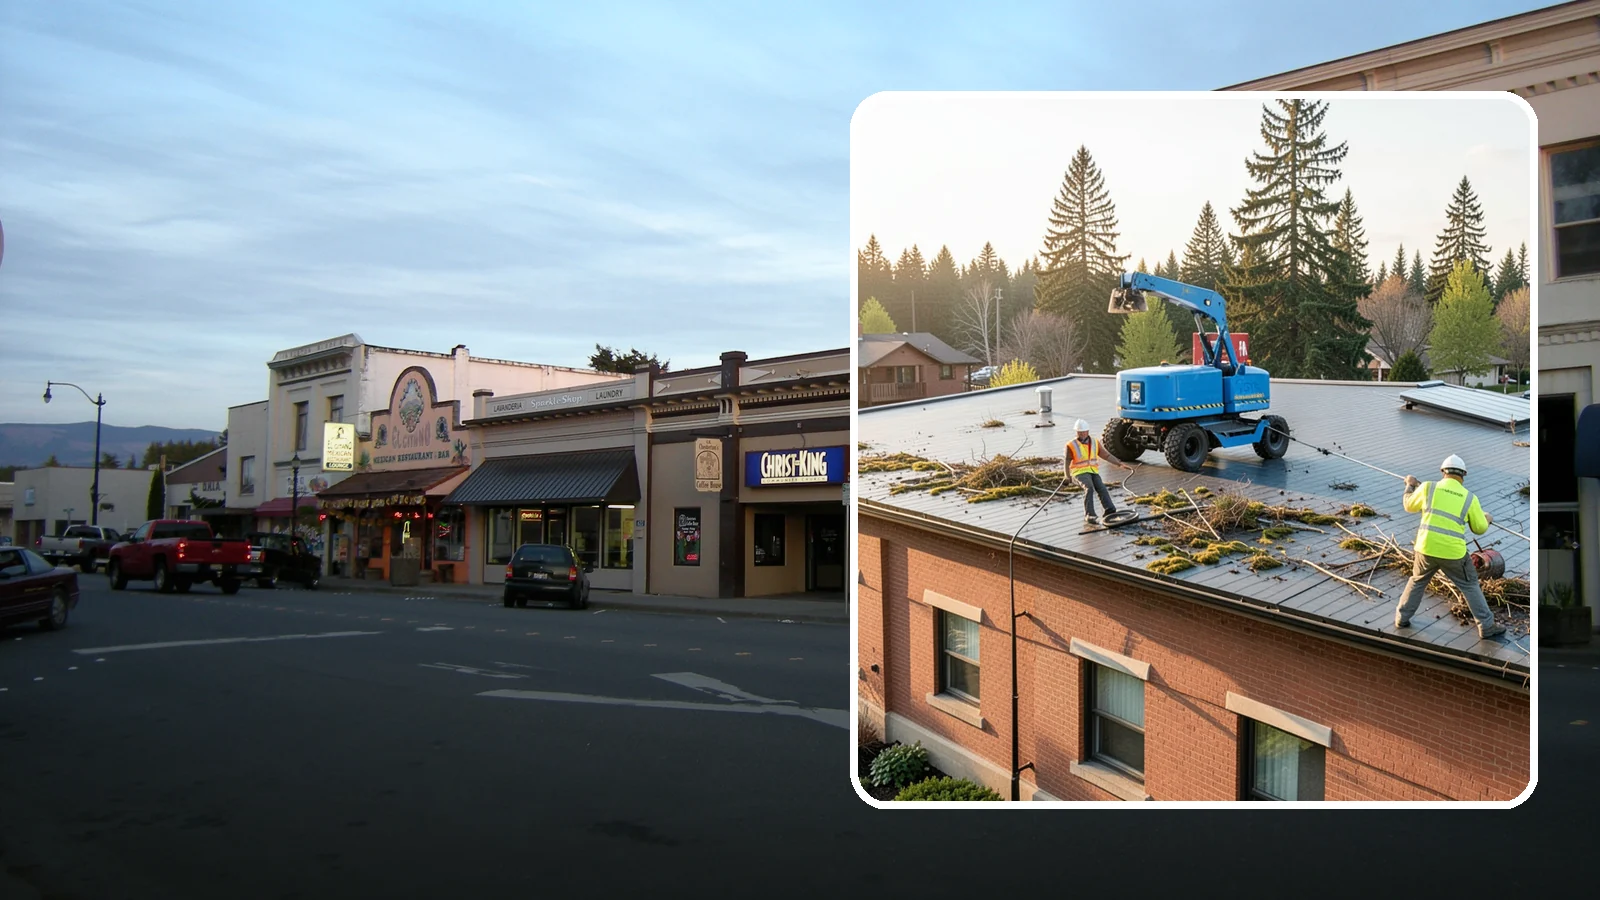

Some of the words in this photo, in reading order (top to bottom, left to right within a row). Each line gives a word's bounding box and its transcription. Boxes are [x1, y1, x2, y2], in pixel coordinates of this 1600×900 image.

[595, 389, 623, 400] LAUNDRY
[493, 402, 523, 413] LAVANDERIA
[530, 396, 561, 409] Sparkle
[562, 394, 582, 405] Shop
[373, 454, 396, 464] MEXICAN
[397, 451, 434, 462] RESTAURANT
[438, 450, 450, 459] BAR
[761, 451, 797, 478] CHRIST
[799, 449, 827, 477] KING
[696, 480, 709, 489] Coffee
[710, 480, 722, 489] House
